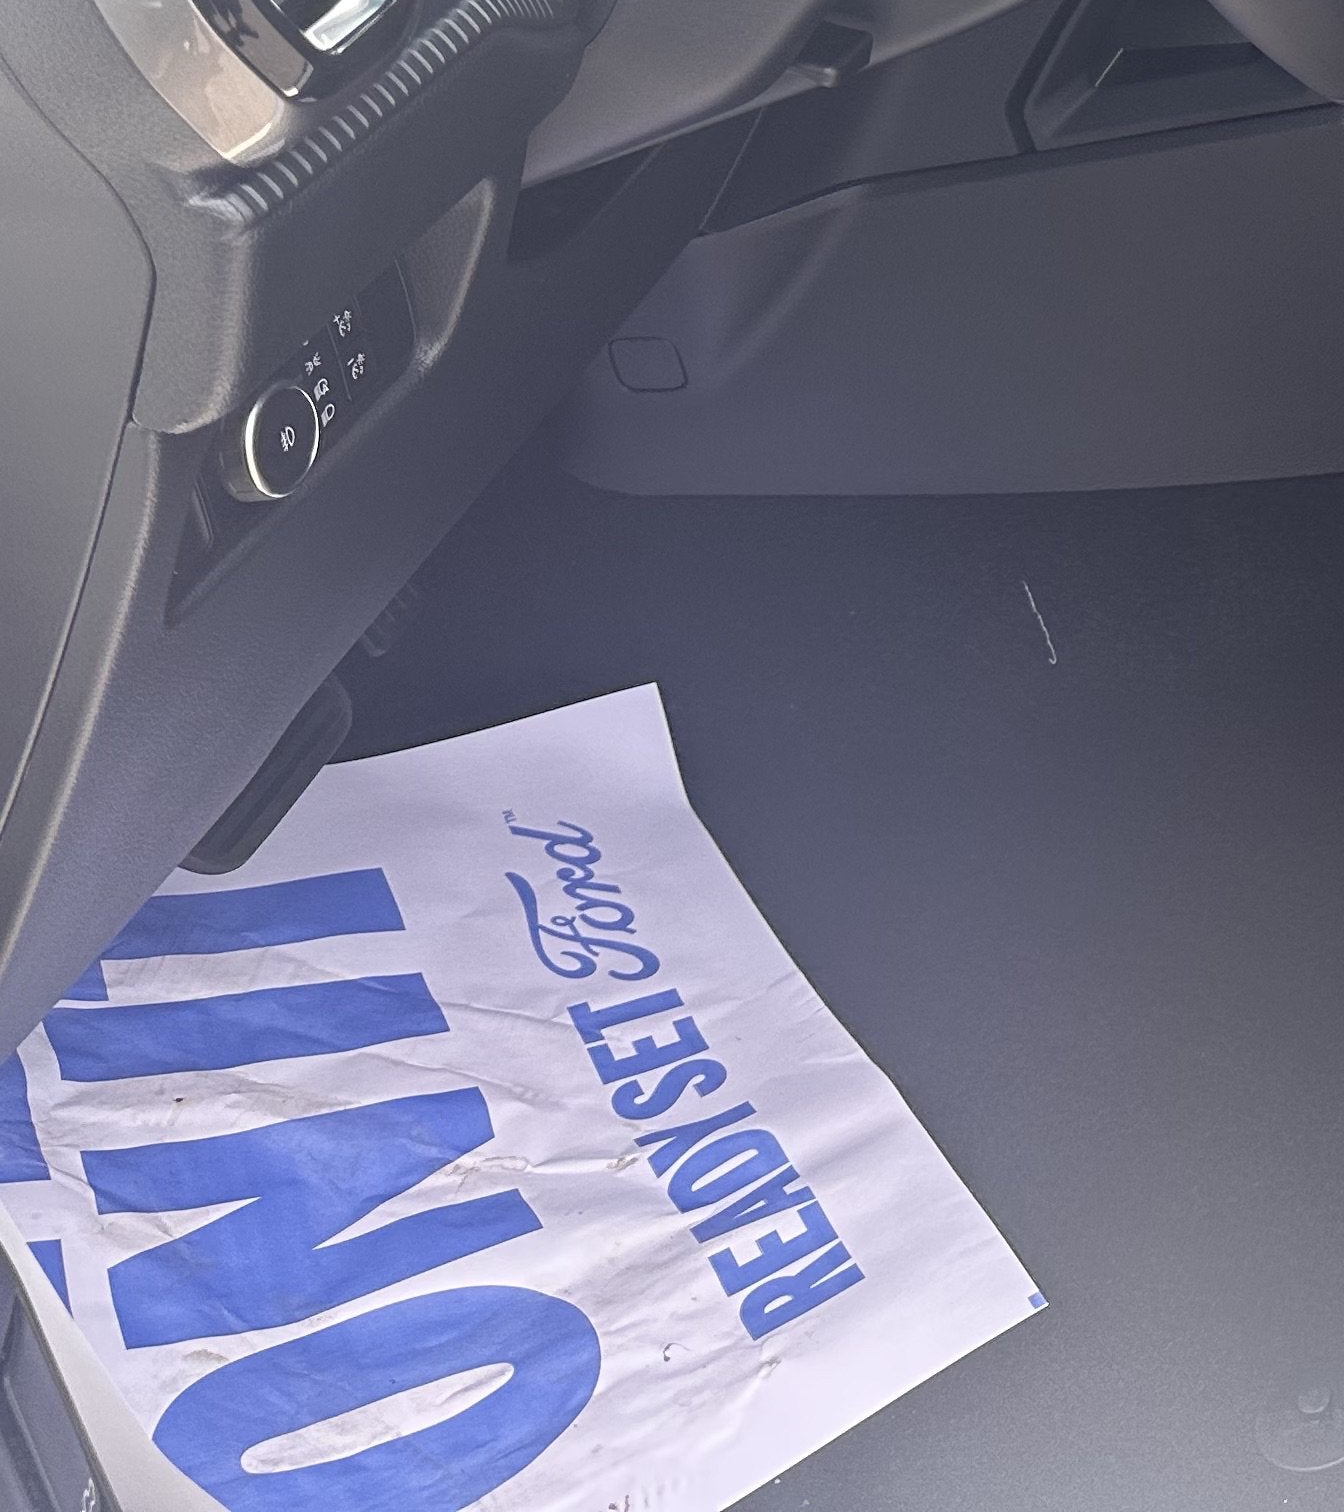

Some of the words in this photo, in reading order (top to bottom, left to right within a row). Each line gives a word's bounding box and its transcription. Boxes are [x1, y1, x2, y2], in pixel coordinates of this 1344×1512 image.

[506, 820, 660, 980] Ford
[568, 989, 727, 1120] SET
[639, 1103, 863, 1339] READY
